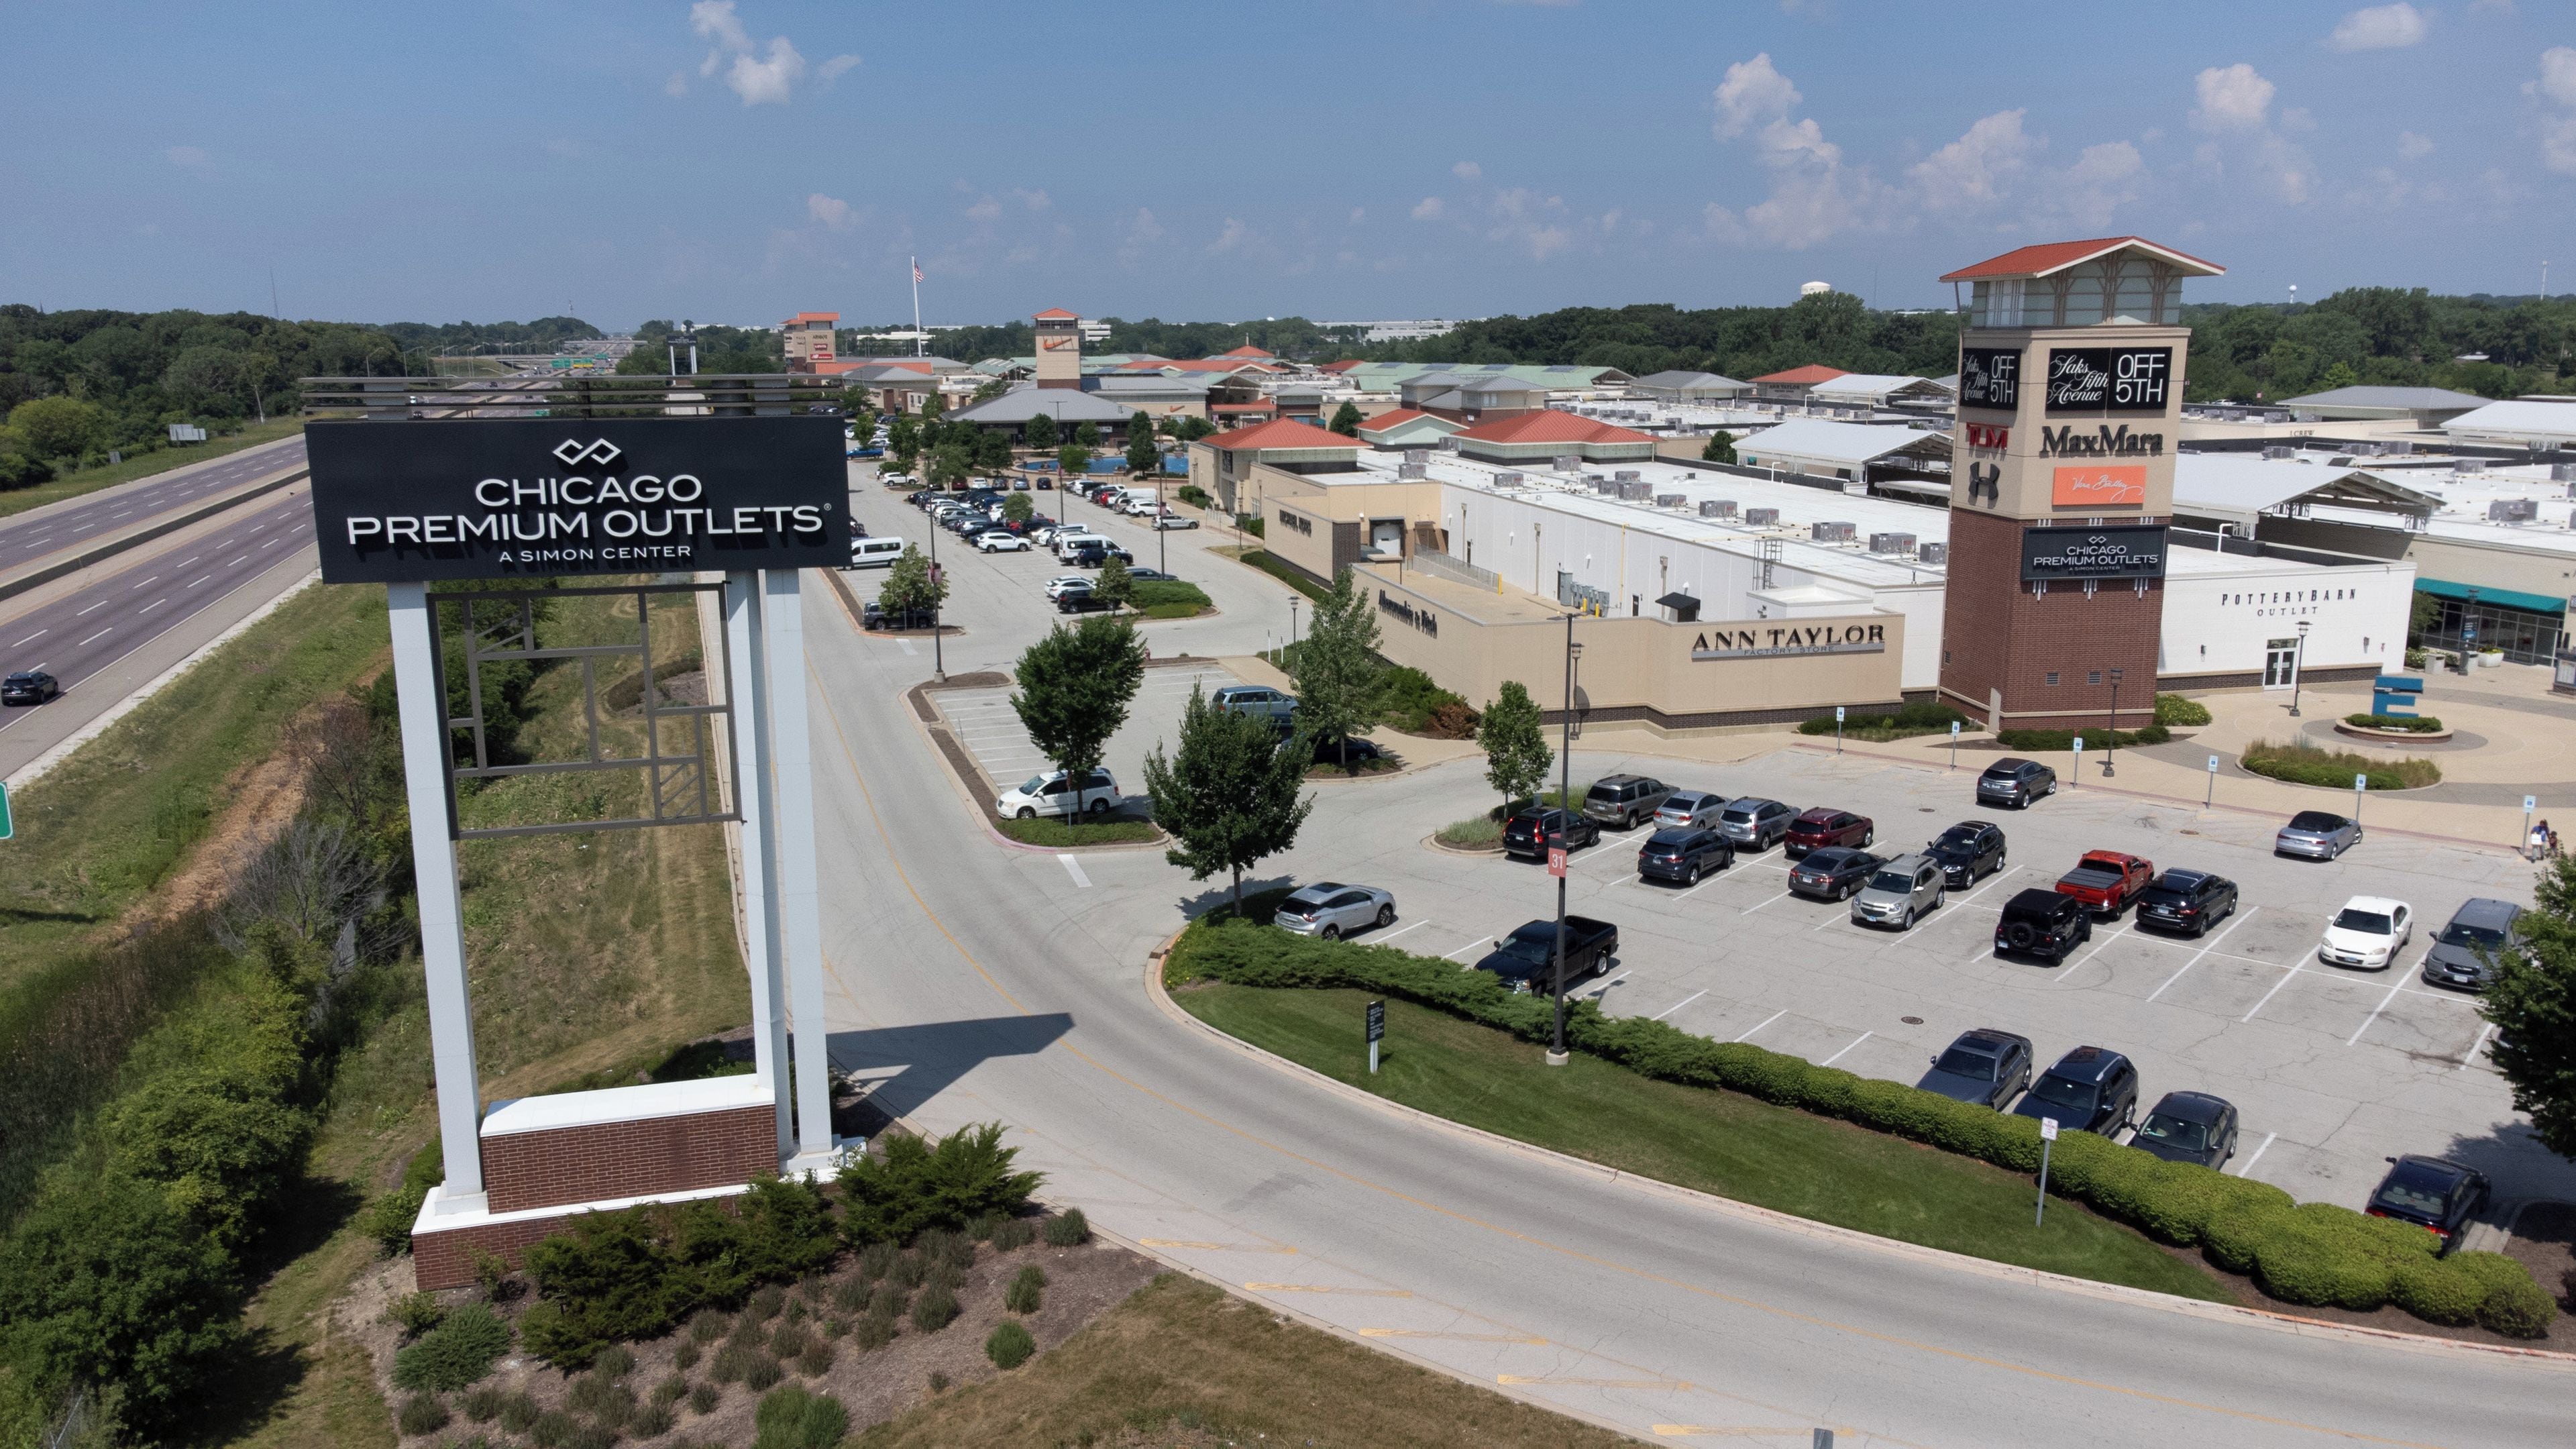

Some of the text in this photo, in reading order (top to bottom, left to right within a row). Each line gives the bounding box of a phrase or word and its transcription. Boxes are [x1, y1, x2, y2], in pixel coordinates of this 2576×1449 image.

[1963, 355, 1979, 376] Saks
[1992, 356, 2015, 379] OFF
[2049, 355, 2088, 378] Saks
[2118, 354, 2165, 379] OFF
[1963, 380, 1986, 400] Avenue
[1990, 380, 2014, 403] 5TH
[2069, 370, 2108, 391] Fifth
[2116, 378, 2163, 402] 5TH
[2047, 382, 2102, 404] Avenue
[2040, 424, 2163, 453] MaxMara
[474, 474, 702, 506] CHICAGO
[2072, 474, 2143, 503] Vera Bradley
[347, 512, 590, 545] PREMIUM
[499, 545, 692, 563] A SIMON CENTER
[2033, 555, 2158, 566] PREMIUM OUTLETS
[2066, 545, 2127, 555] CHICAGO
[2311, 589, 2356, 601] BARN
[2257, 606, 2318, 616] OUTLET
[1693, 625, 1885, 650] ANN TAYLOR
[1744, 647, 1792, 655] FACTORY
[1552, 853, 1563, 869] 31
